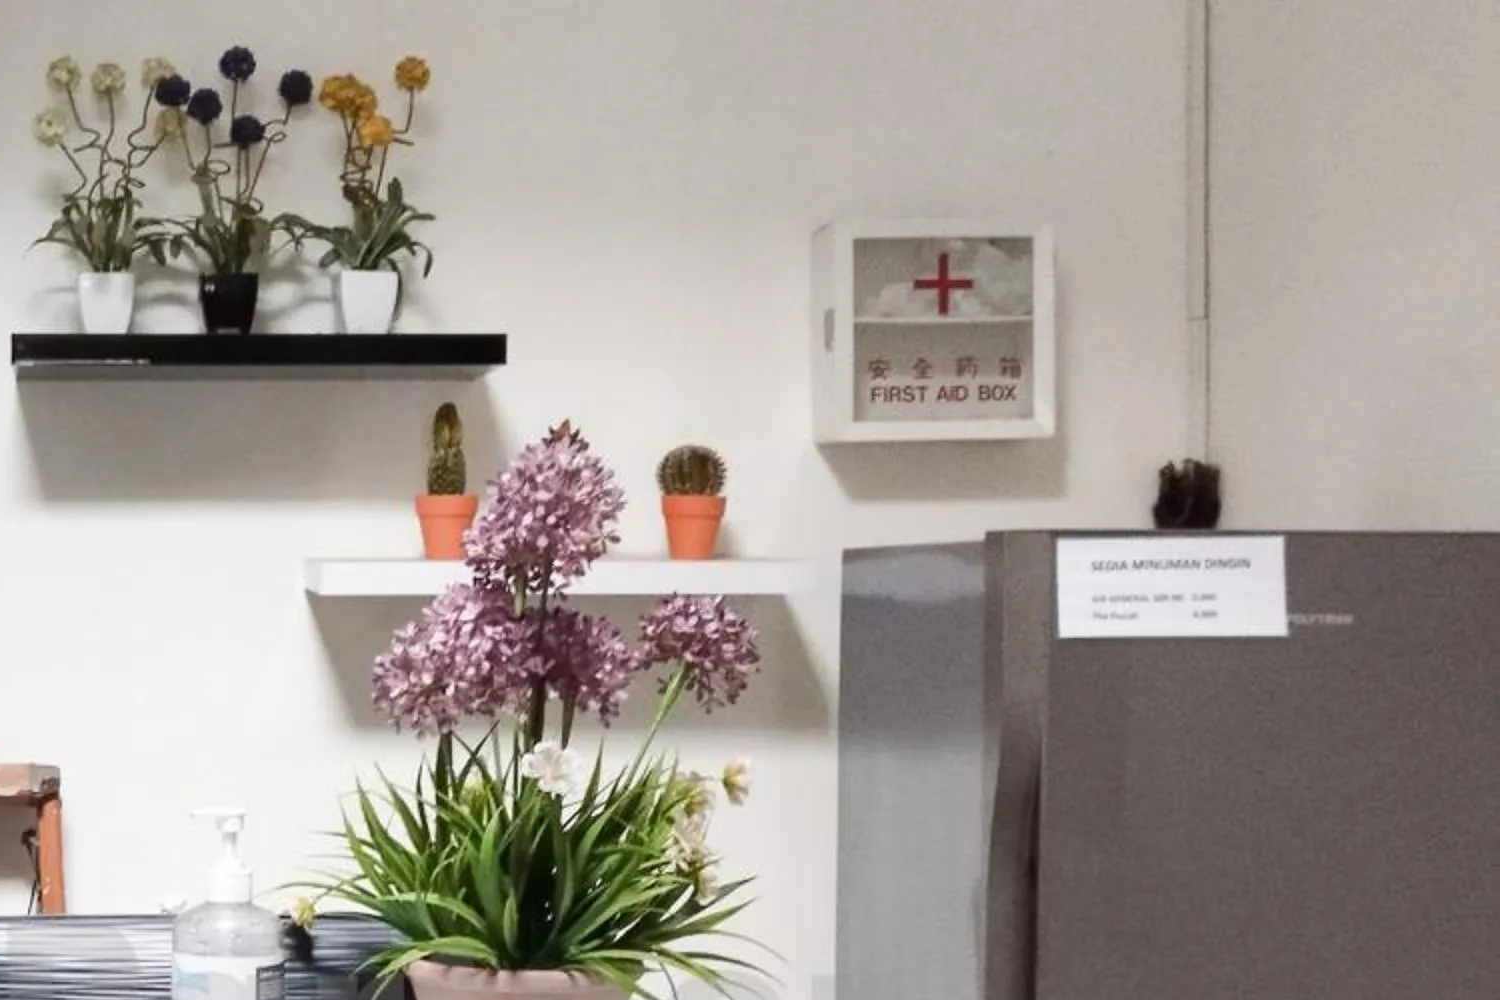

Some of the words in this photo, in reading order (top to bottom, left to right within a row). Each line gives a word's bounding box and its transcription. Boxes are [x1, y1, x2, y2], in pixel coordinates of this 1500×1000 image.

[871, 385, 929, 402] FIRST
[936, 385, 970, 402] AID
[979, 384, 1018, 402] BOX
[1132, 558, 1200, 571] MINUMAN
